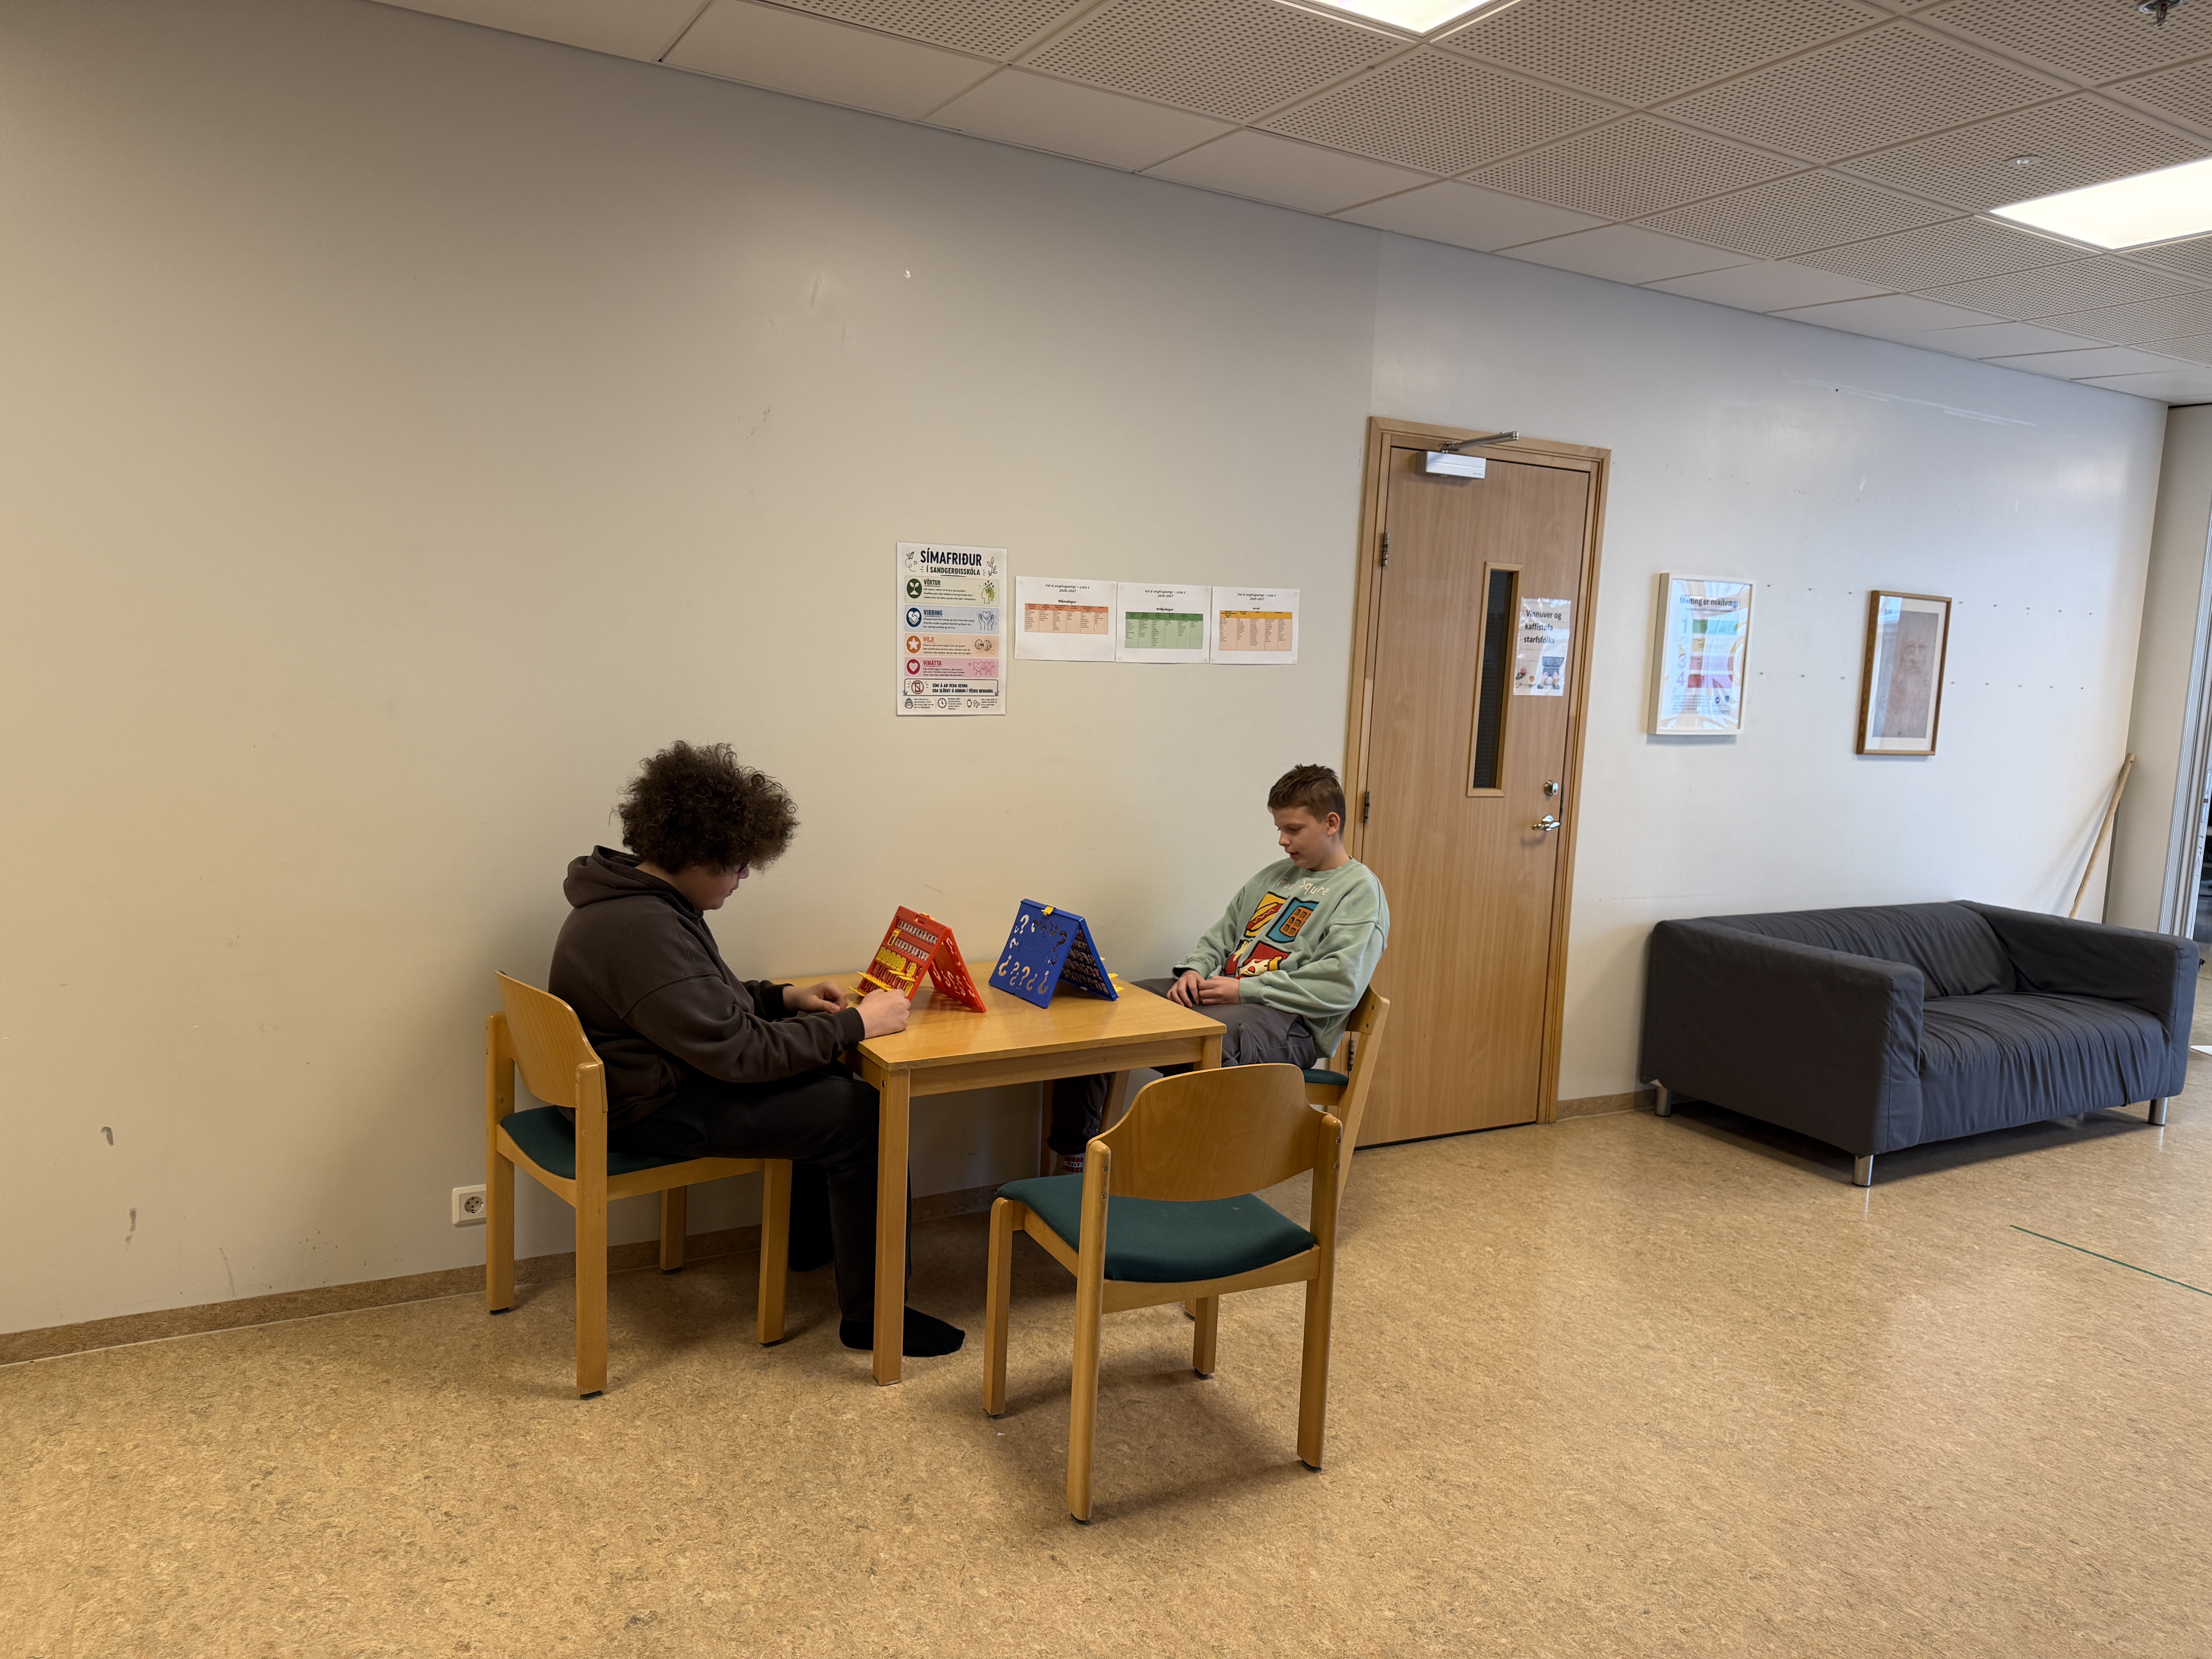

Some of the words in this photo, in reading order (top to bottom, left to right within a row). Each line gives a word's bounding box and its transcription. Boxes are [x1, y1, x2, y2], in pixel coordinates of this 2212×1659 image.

[920, 548, 982, 566] SÍMAFRIÐUR
[930, 567, 981, 575] SANDGERÐISSKÓLA
[1526, 610, 1553, 619] Vinnuver
[1525, 623, 1553, 631] kaffistofa
[1523, 636, 1555, 644] starfsfólks
[1676, 672, 1685, 686] 4
[1299, 877, 1329, 896] Squre
